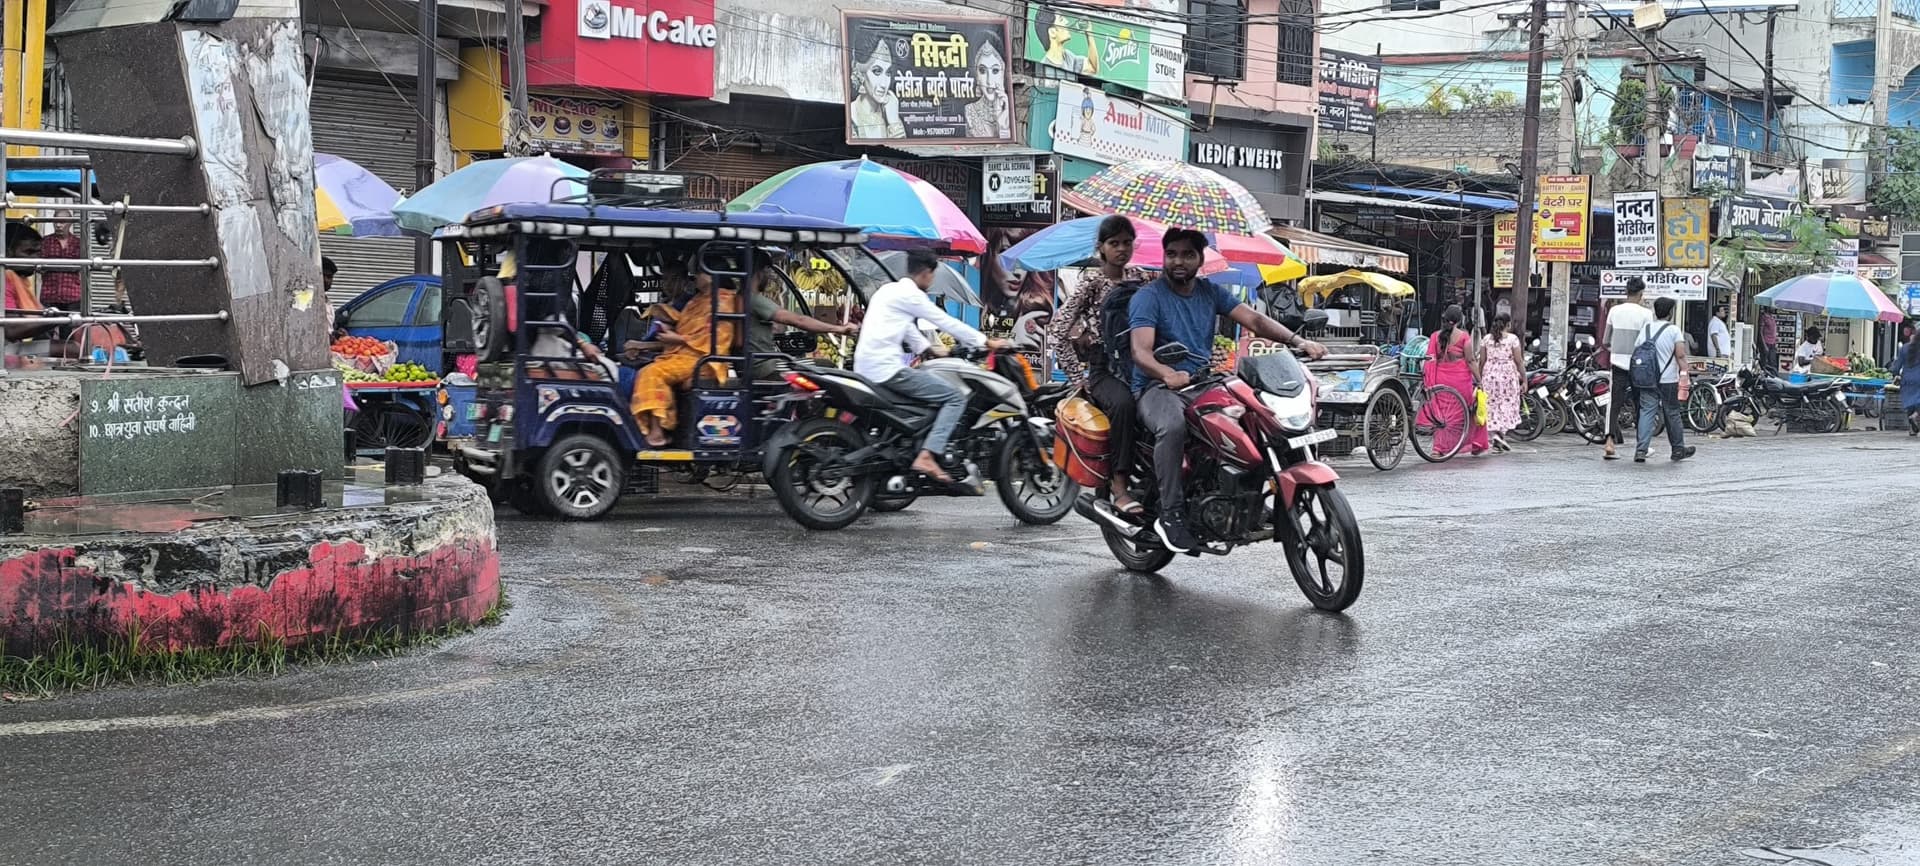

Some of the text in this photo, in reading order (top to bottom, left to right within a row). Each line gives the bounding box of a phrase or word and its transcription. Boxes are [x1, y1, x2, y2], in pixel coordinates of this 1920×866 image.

[1105, 41, 1138, 65] Sprite
[1151, 44, 1182, 65] CHANDAN
[1155, 63, 1177, 79] STORE
[894, 70, 924, 98] लेडीज
[949, 71, 975, 98] पार्लर
[562, 100, 597, 116] Cake
[1103, 101, 1143, 131] Amul
[1145, 117, 1171, 138] Milk
[1197, 142, 1284, 170] KEDIA SWEETS
[1004, 175, 1031, 184] ADVOCATE
[1568, 199, 1582, 207] घर
[1615, 199, 1655, 218] नन्दन
[1616, 219, 1655, 236] मेडिसिन
[1646, 271, 1689, 284] मेडिसिन
[107, 391, 119, 413] श्री
[124, 391, 154, 414] सतीश
[158, 395, 190, 412] कुन्दन
[144, 415, 167, 435] संघर्ष
[168, 411, 195, 433] वाहिनी
